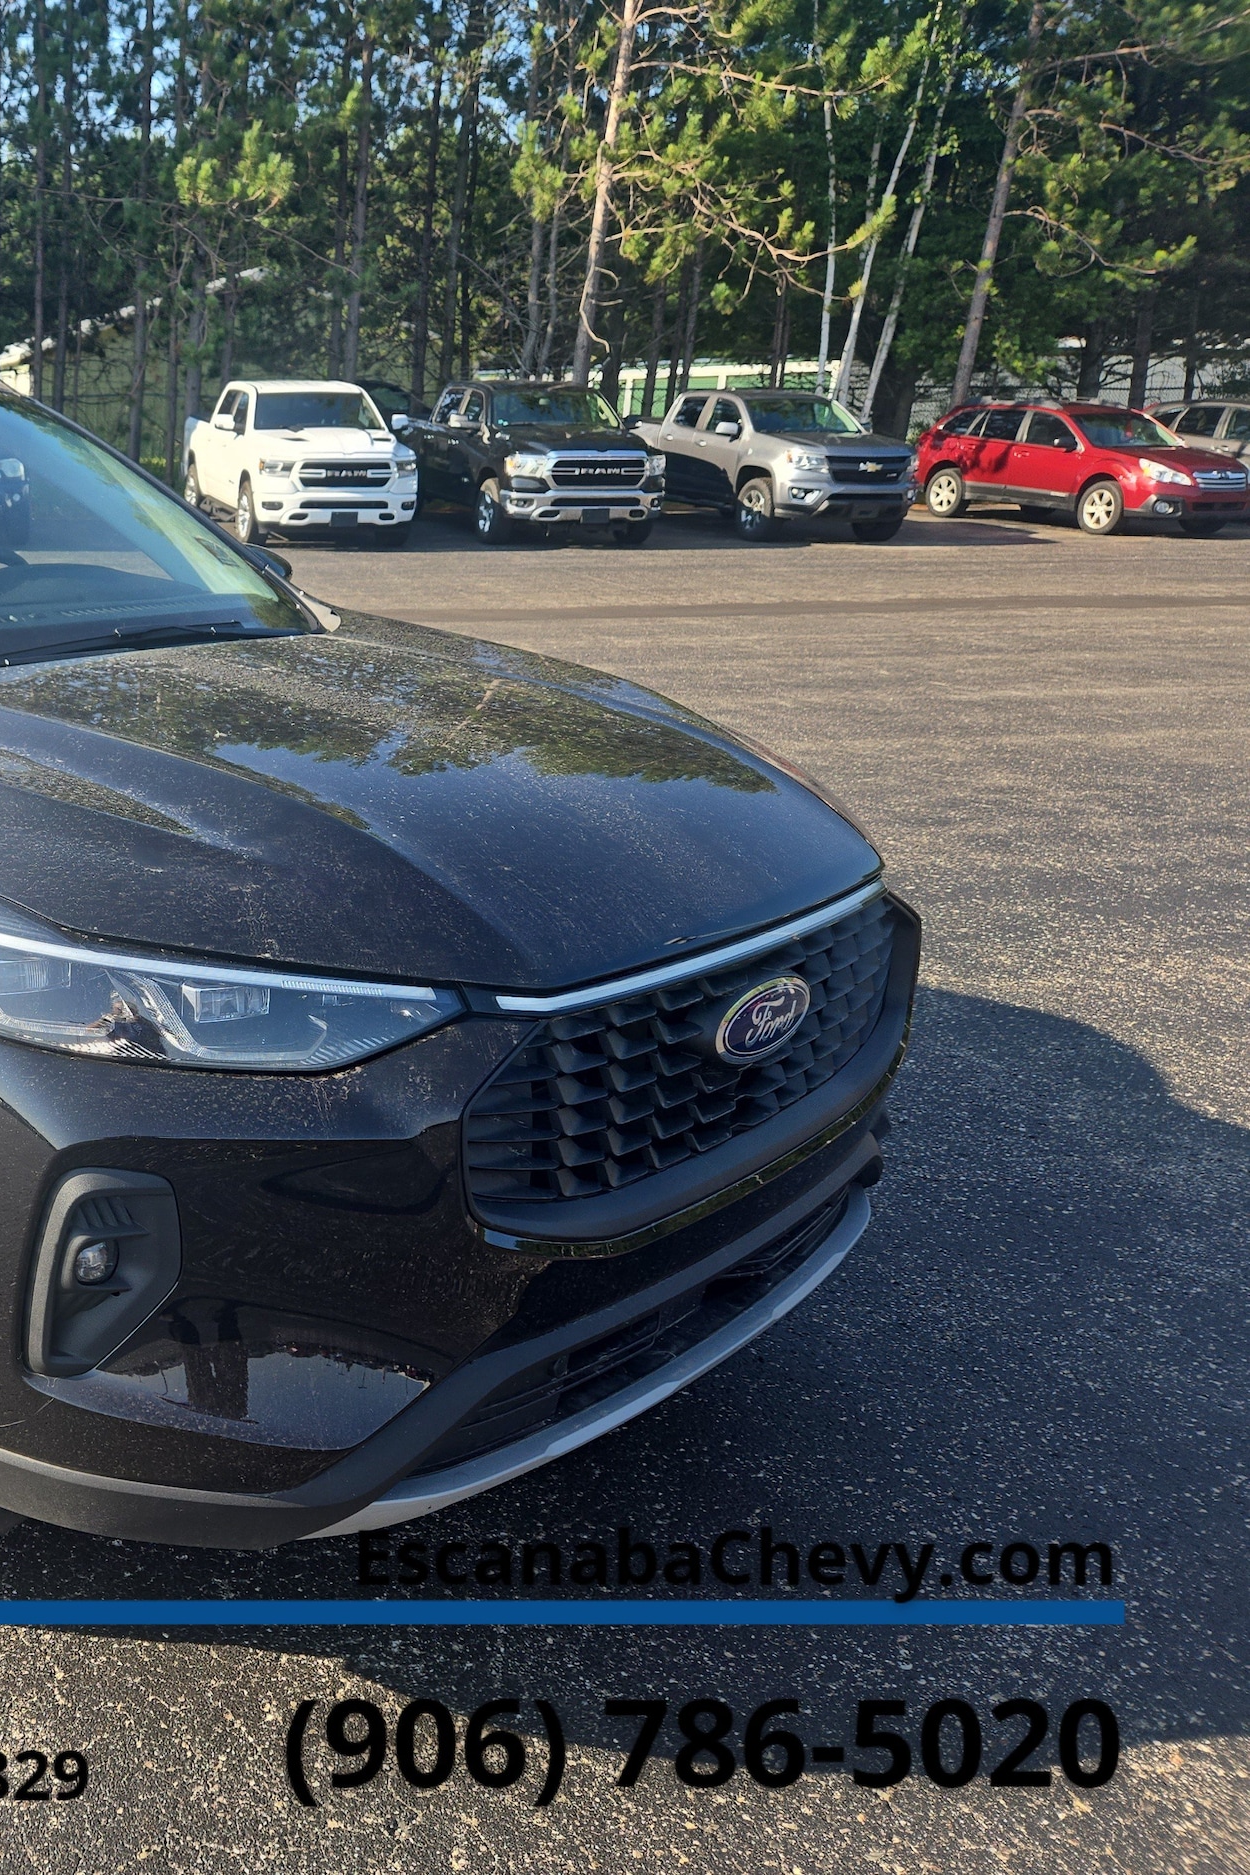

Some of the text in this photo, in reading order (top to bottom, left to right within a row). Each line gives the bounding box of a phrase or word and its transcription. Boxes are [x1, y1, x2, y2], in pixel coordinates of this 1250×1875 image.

[326, 469, 367, 477] RAM
[580, 467, 621, 475] RAM
[746, 996, 797, 1047] Ford
